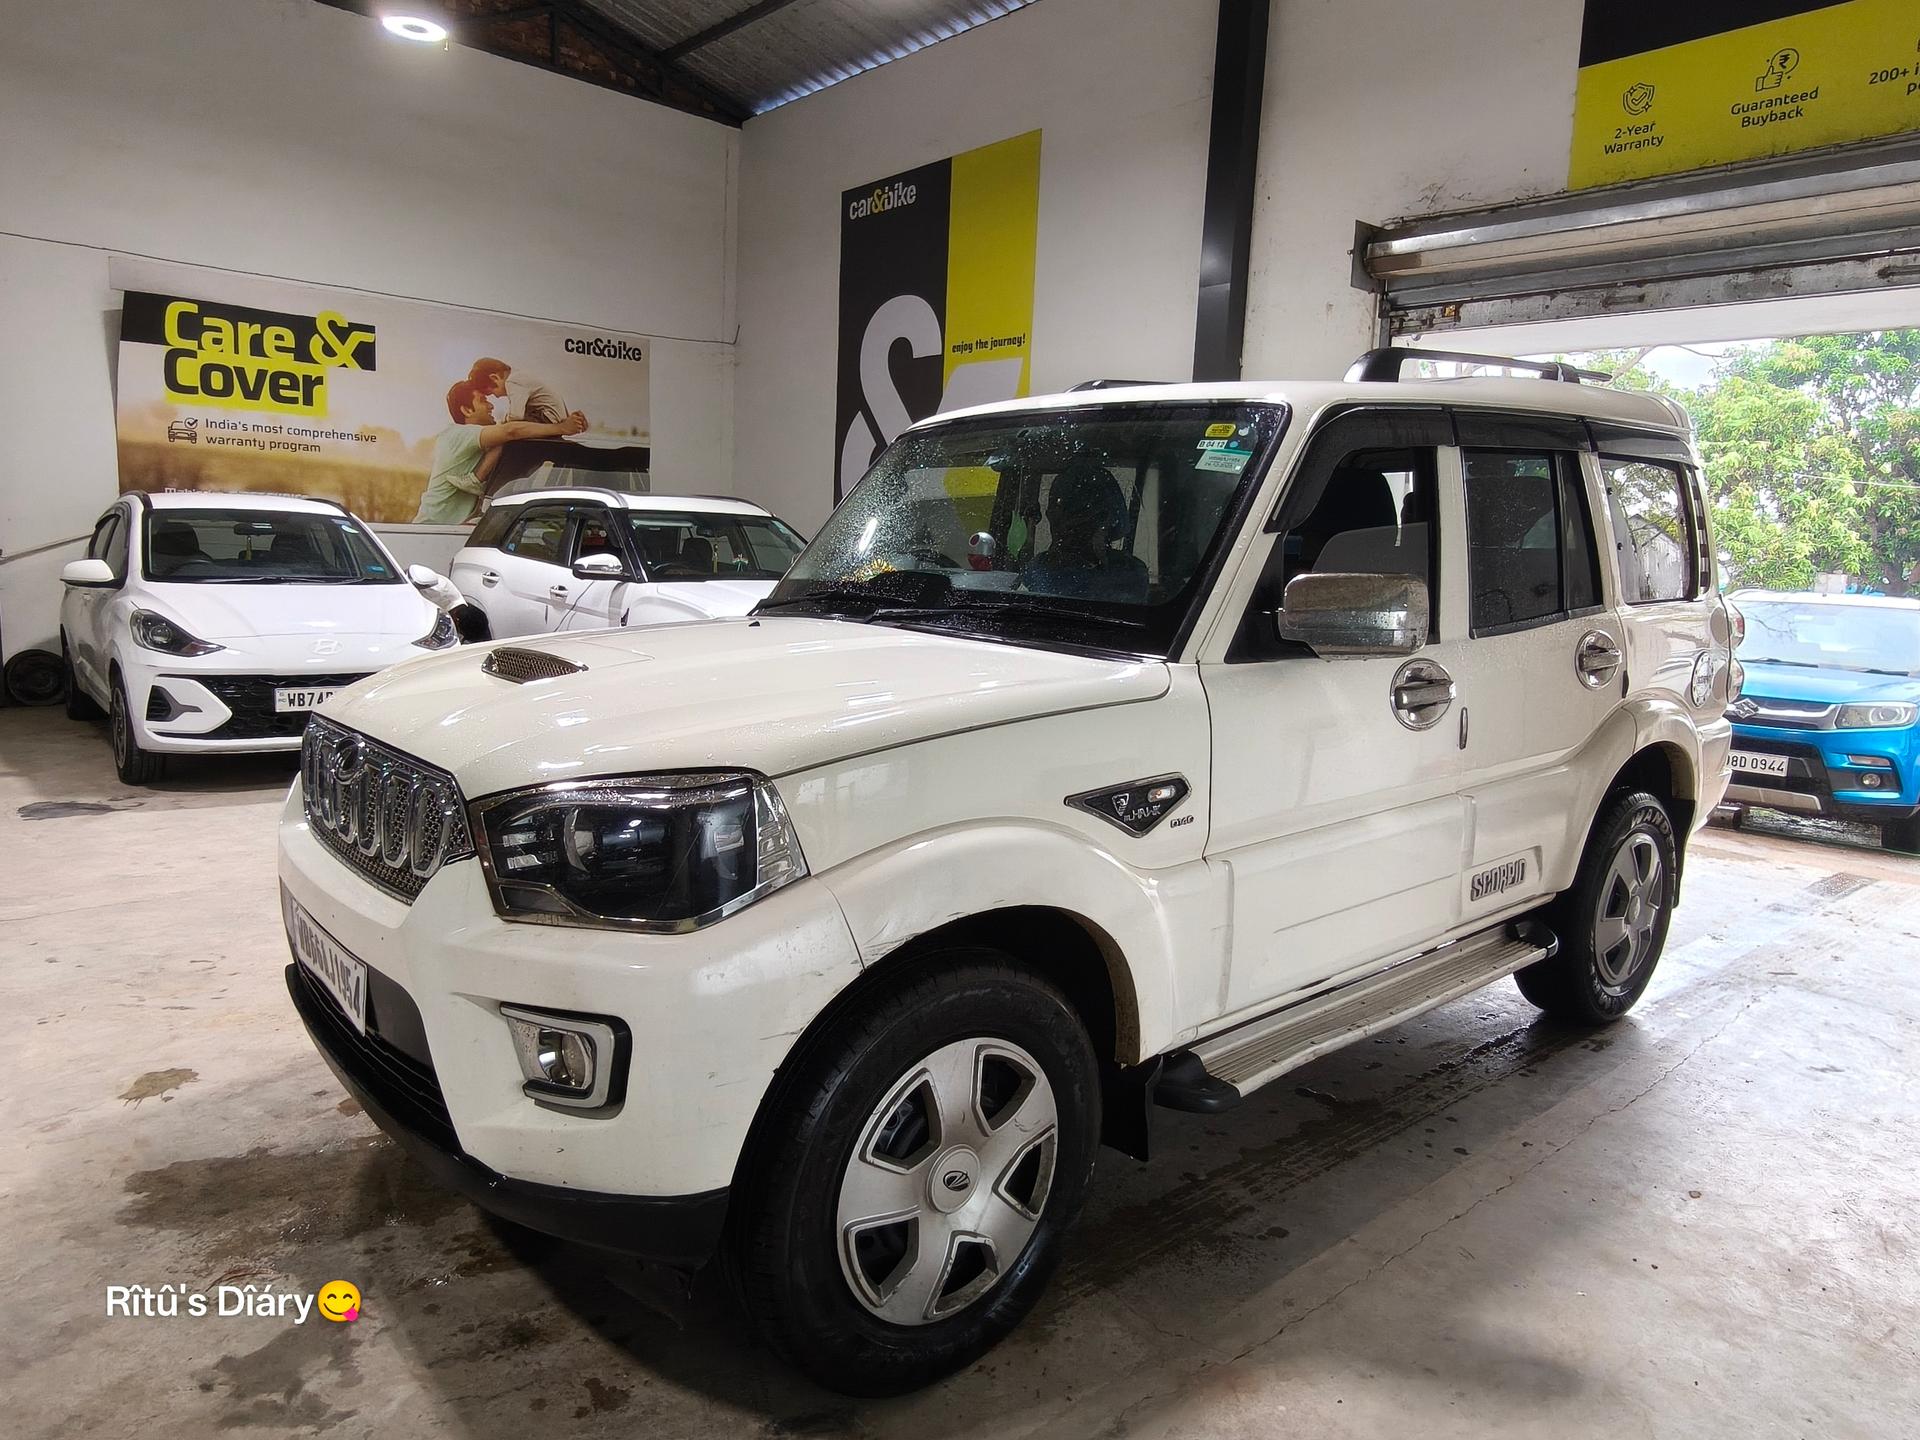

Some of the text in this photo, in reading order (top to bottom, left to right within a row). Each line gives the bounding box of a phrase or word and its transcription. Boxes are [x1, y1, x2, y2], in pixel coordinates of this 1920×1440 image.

[1868, 67, 1909, 85] 200+
[1731, 86, 1819, 115] Guaranteed
[1741, 105, 1804, 128] Buyback
[1614, 121, 1656, 139] 2-Year
[1604, 135, 1664, 155] Warranty
[164, 300, 376, 370] Care &
[952, 332, 1026, 354] enjoy the journey!
[163, 347, 324, 407] Cover
[205, 418, 377, 443] India's most comprehensive
[205, 436, 321, 453] warranty program
[1750, 757, 1785, 772] 0944
